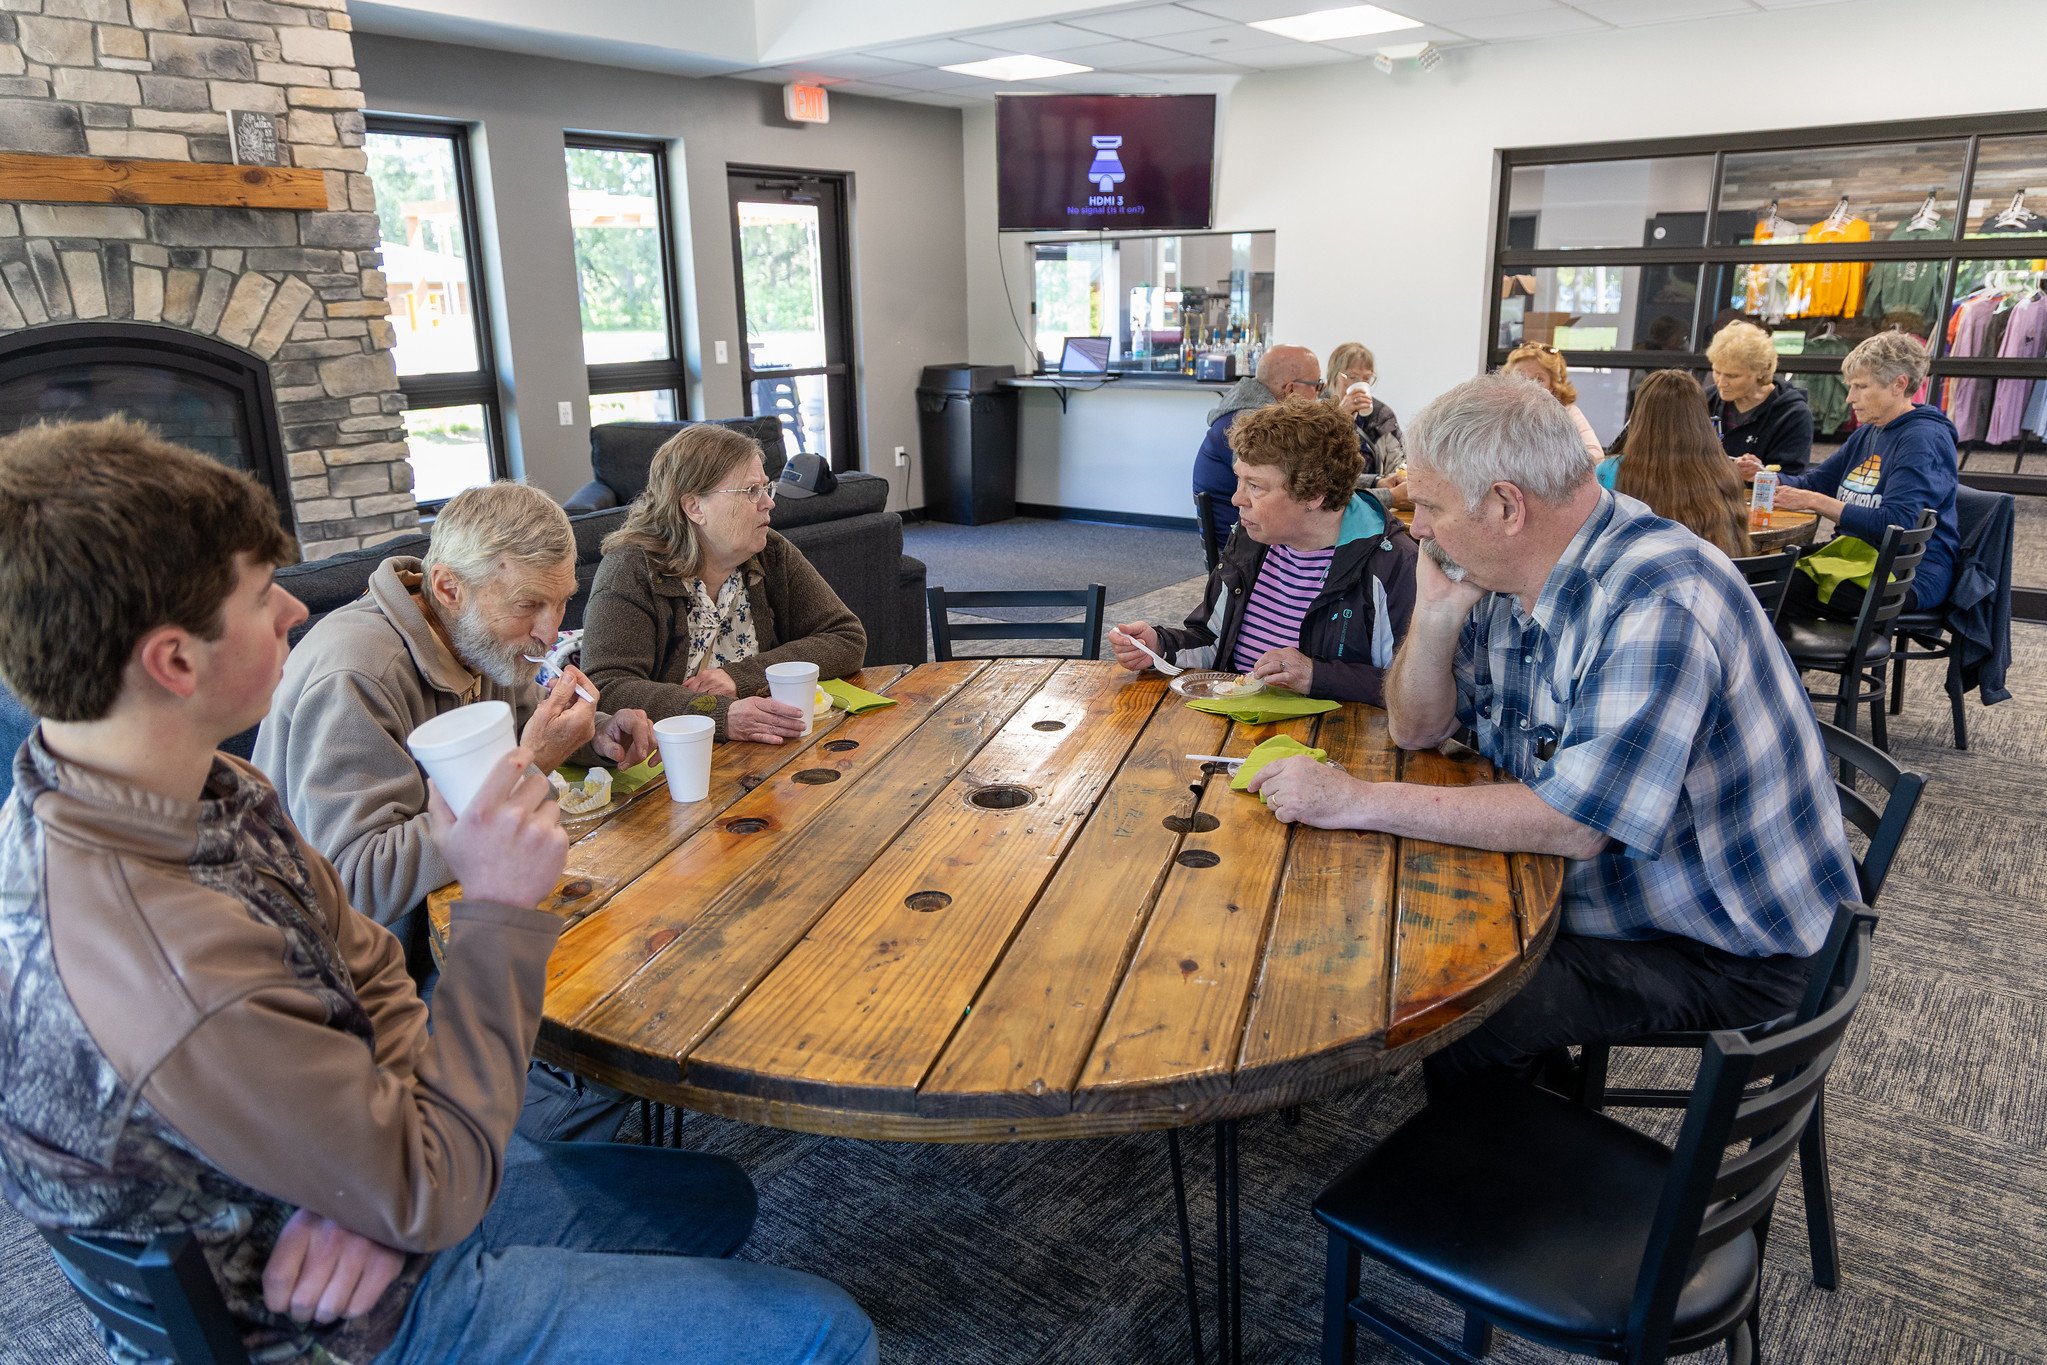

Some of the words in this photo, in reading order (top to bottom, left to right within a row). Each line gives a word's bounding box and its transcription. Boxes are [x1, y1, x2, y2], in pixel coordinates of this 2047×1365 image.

[795, 86, 824, 119] EXIT
[1089, 195, 1115, 206] HDMI
[1116, 195, 1124, 206] 3
[1067, 206, 1080, 215] No
[1081, 206, 1105, 217] signal
[1107, 206, 1117, 215] (is
[1119, 206, 1125, 215] it
[1126, 205, 1145, 216] on?)
